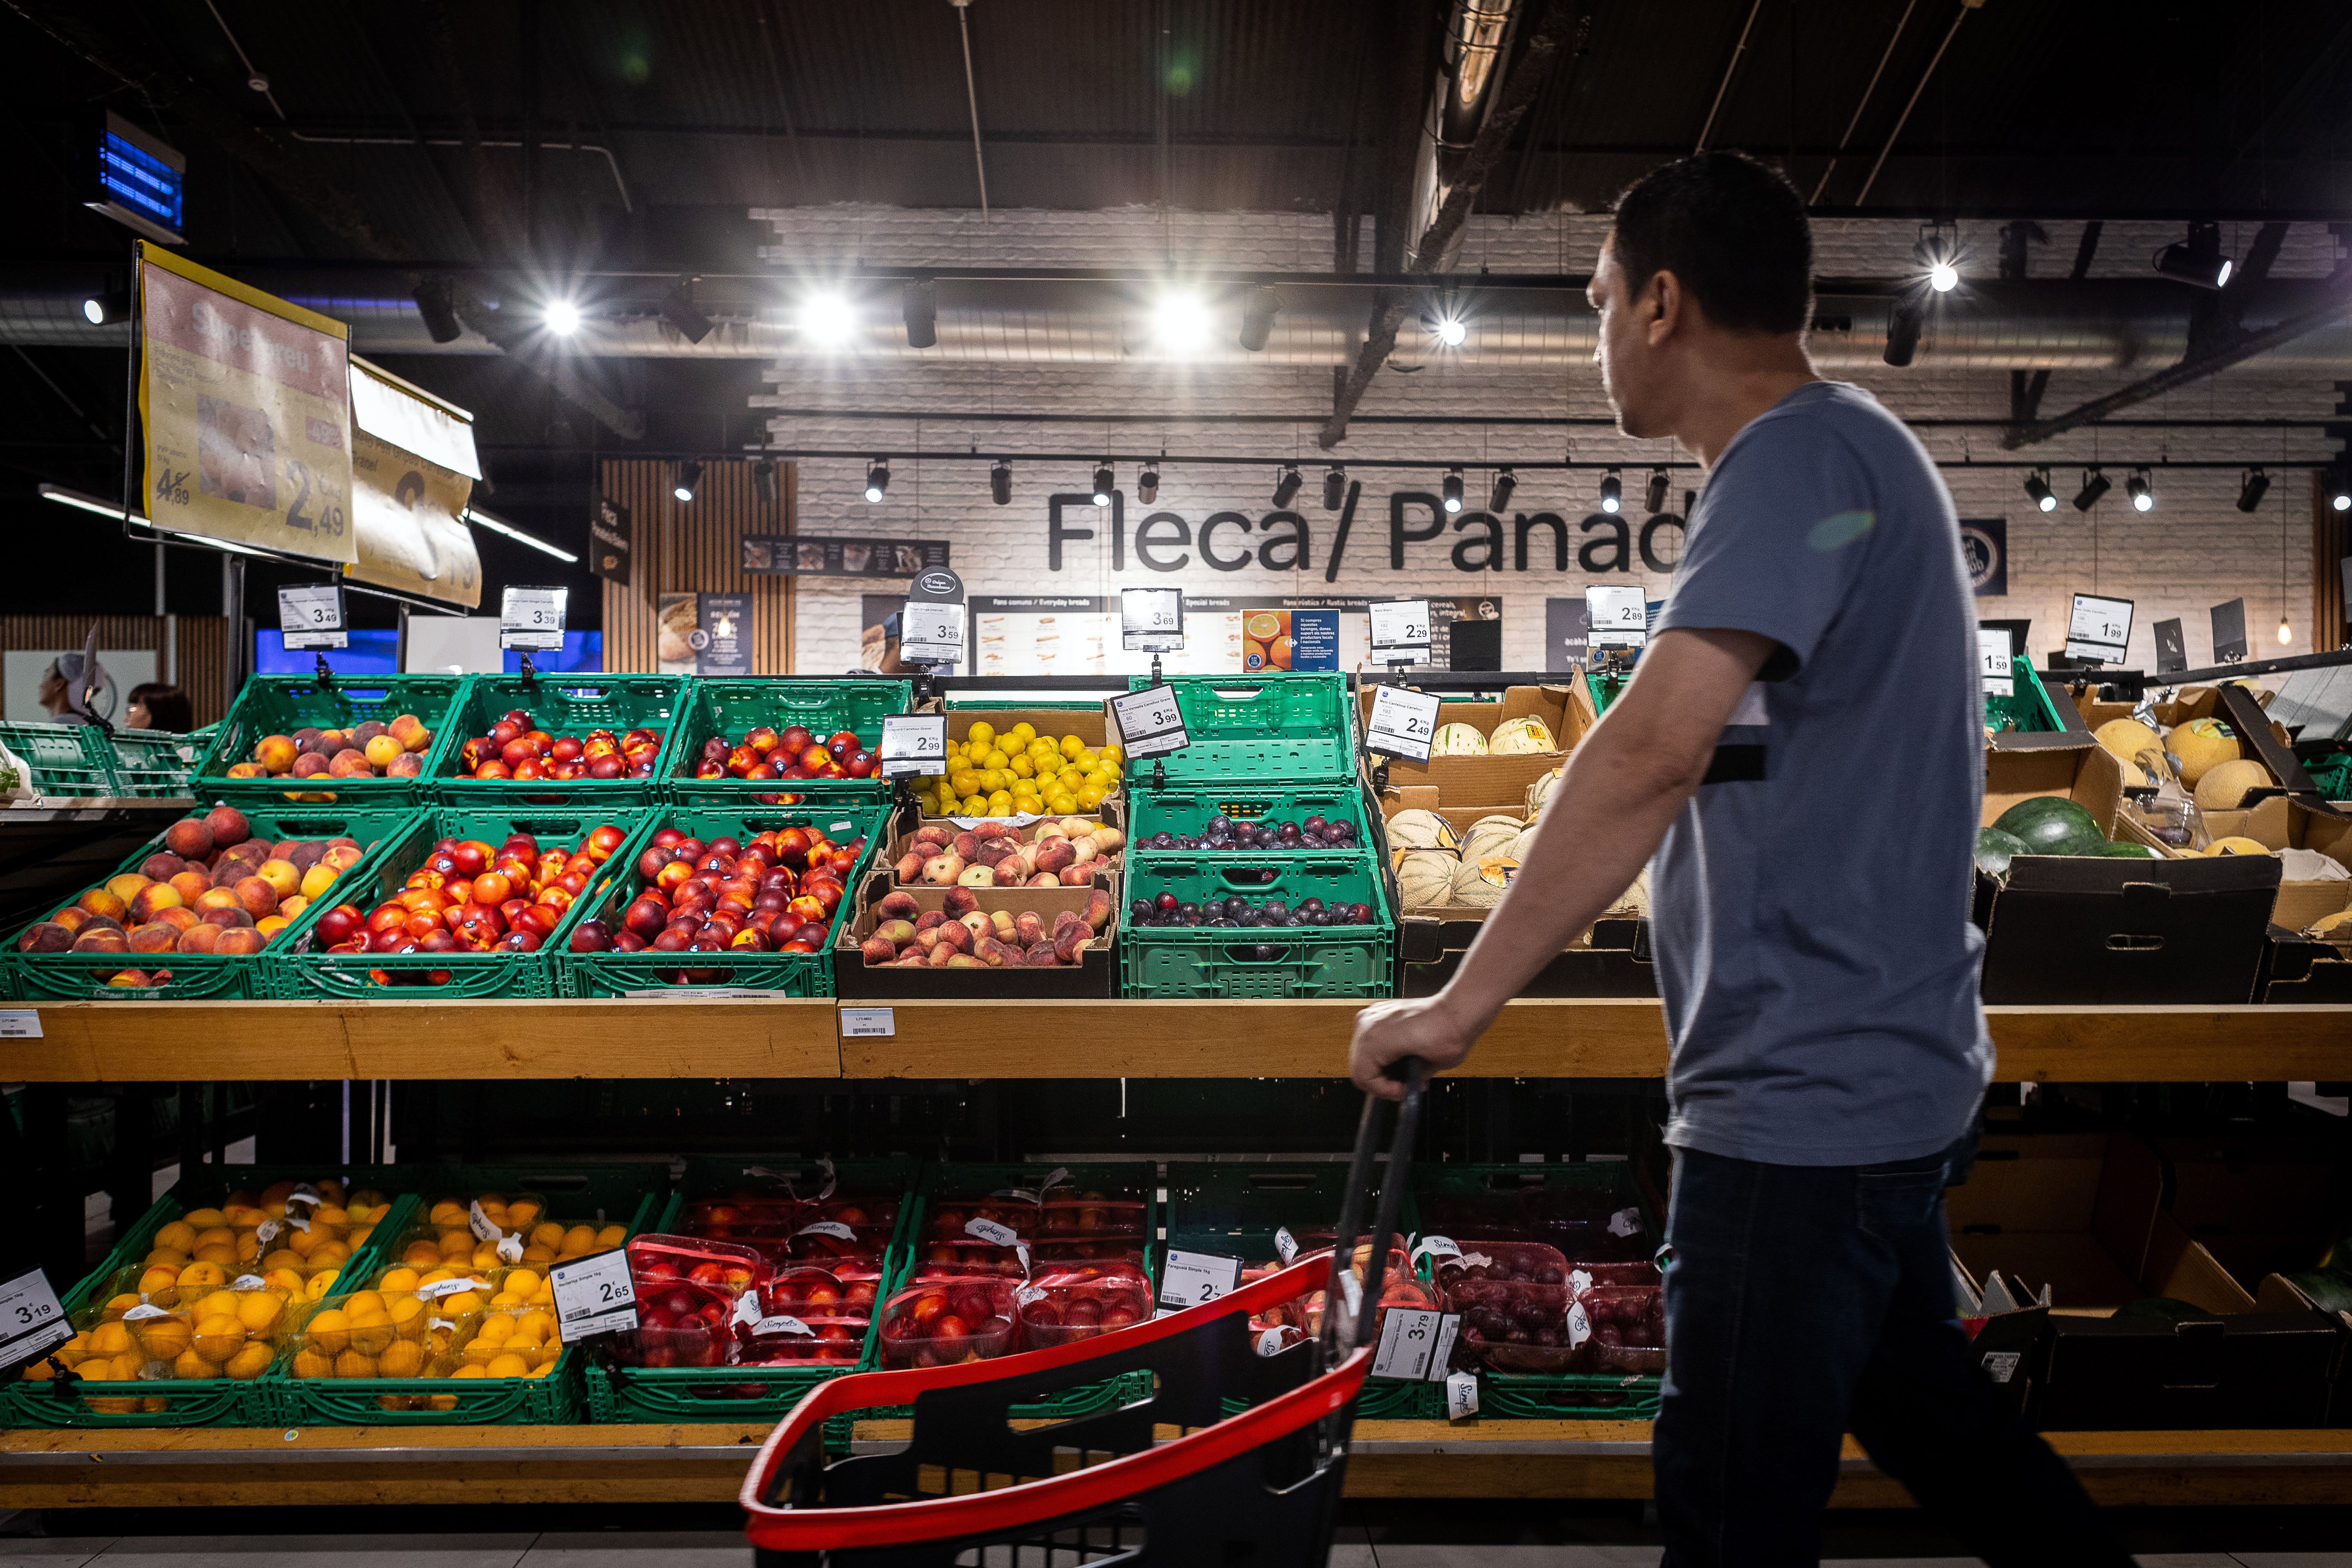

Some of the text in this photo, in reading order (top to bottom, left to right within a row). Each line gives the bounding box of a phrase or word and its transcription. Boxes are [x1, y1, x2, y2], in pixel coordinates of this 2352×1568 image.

[1049, 490, 1310, 571] Fleca
[314, 609, 323, 622] 3
[533, 611, 542, 623] 3
[1153, 612, 1162, 625] 3
[1622, 607, 1631, 620] 2
[938, 625, 946, 638] 3
[1406, 625, 1416, 638] 2
[2102, 623, 2109, 636] 1
[2111, 629, 2121, 638] 99
[1985, 655, 1992, 669] 1
[1996, 662, 2007, 670] 59
[1153, 712, 1164, 725] 3
[1165, 714, 1177, 723] 99
[1406, 718, 1418, 733] 2
[1418, 727, 1429, 735] 49
[917, 737, 927, 750] 2
[558, 1279, 578, 1287] Nectarina
[578, 1274, 593, 1282] Simple
[600, 1283, 614, 1303] 2
[615, 1285, 630, 1298] 65
[1199, 1283, 1213, 1301] 2
[15, 1307, 33, 1324] 3
[34, 1304, 51, 1317] 19
[1408, 1328, 1425, 1340] 3
[1418, 1315, 1429, 1328] 79
